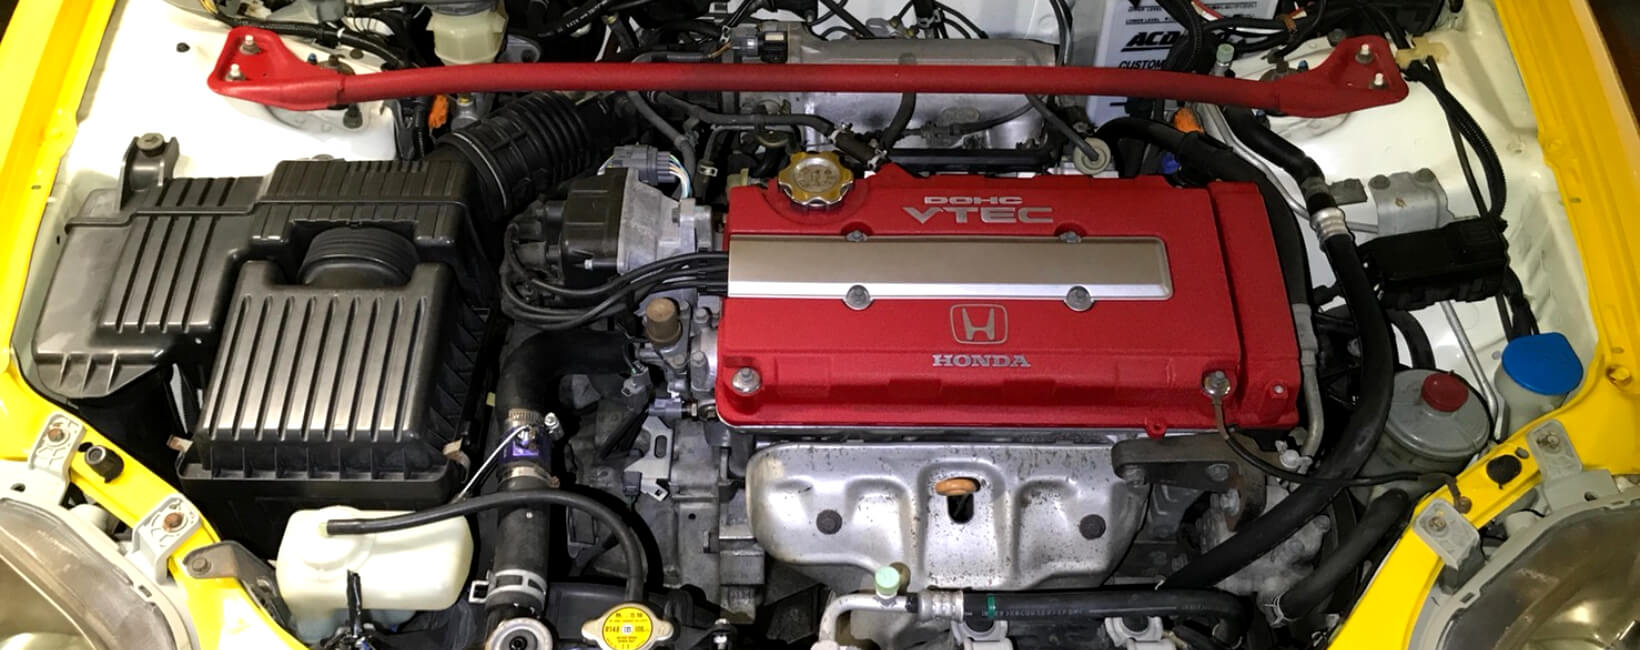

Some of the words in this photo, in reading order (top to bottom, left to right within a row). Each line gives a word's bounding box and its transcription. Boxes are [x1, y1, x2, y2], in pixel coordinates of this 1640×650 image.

[924, 196, 1023, 204] DOHC
[903, 206, 1054, 224] VTEC
[932, 353, 1031, 368] HONDA
